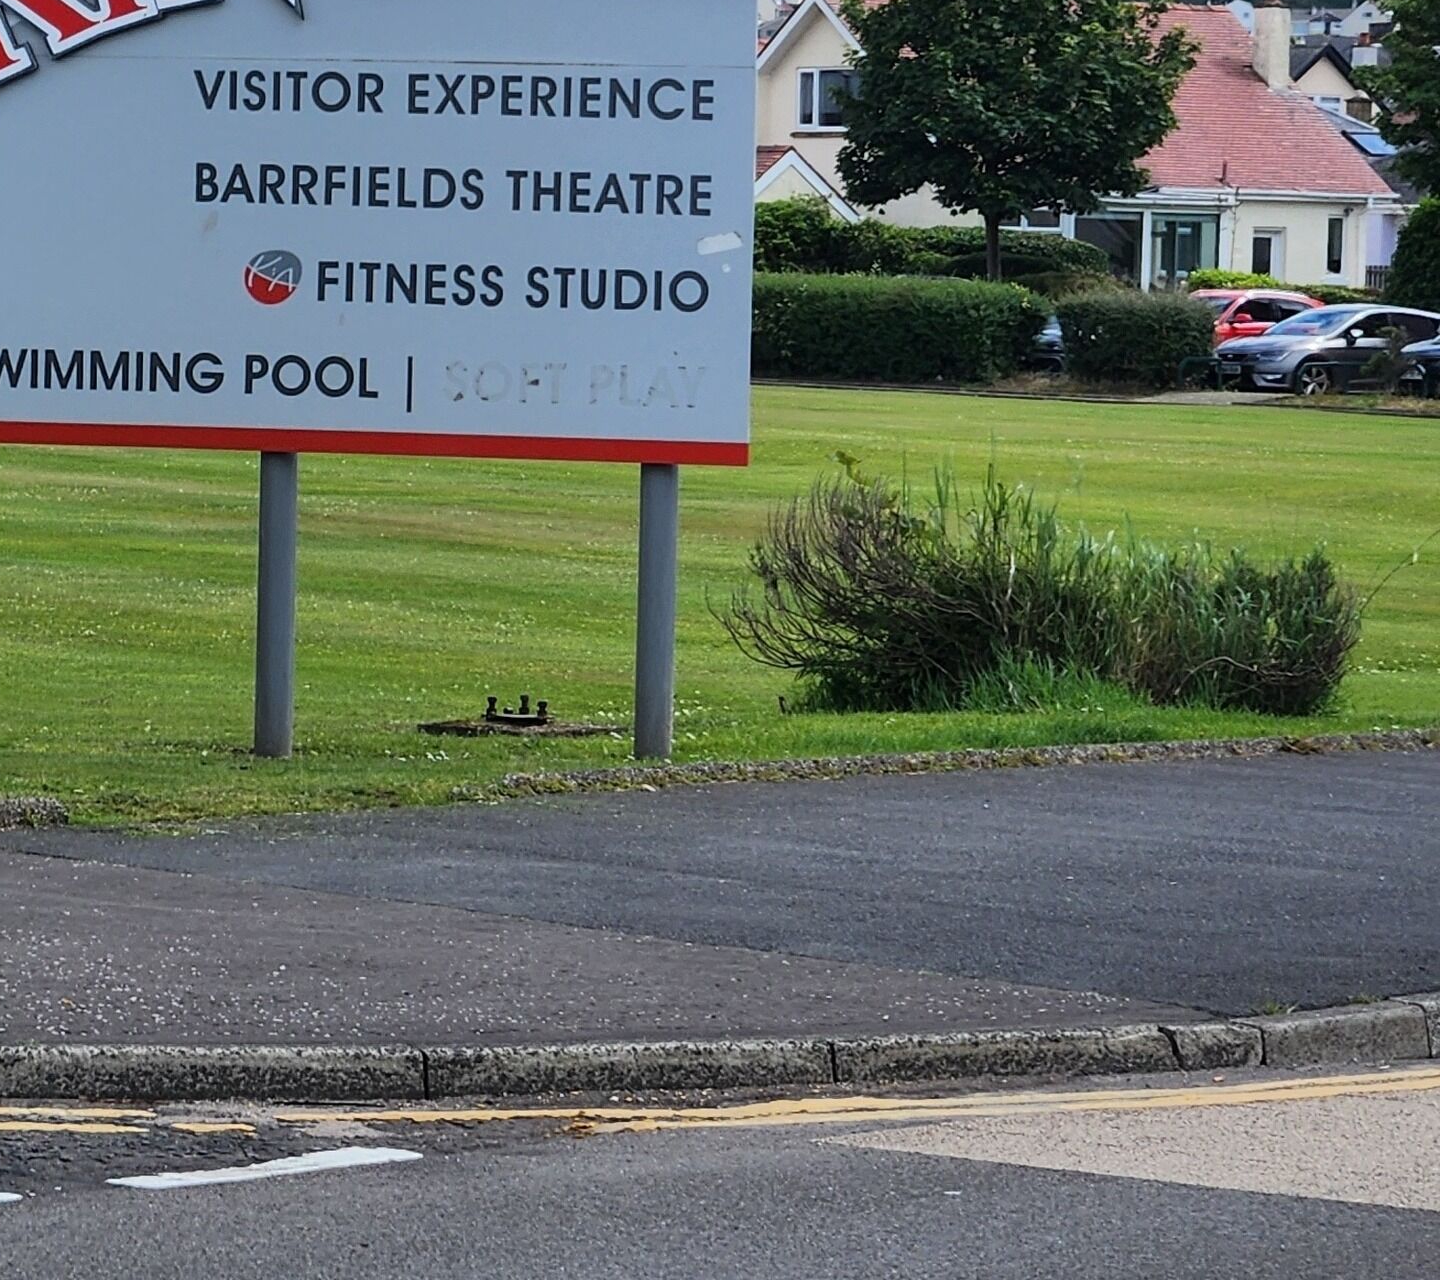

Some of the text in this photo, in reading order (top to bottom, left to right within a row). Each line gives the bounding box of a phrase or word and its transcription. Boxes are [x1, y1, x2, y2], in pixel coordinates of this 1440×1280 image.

[193, 69, 715, 121] VISITOR EXPERIENCE
[194, 161, 713, 217] BARRFIELDS THEATRE
[316, 260, 504, 307] FITNESS
[525, 265, 710, 313] STUDIO
[244, 352, 379, 399] POOL
